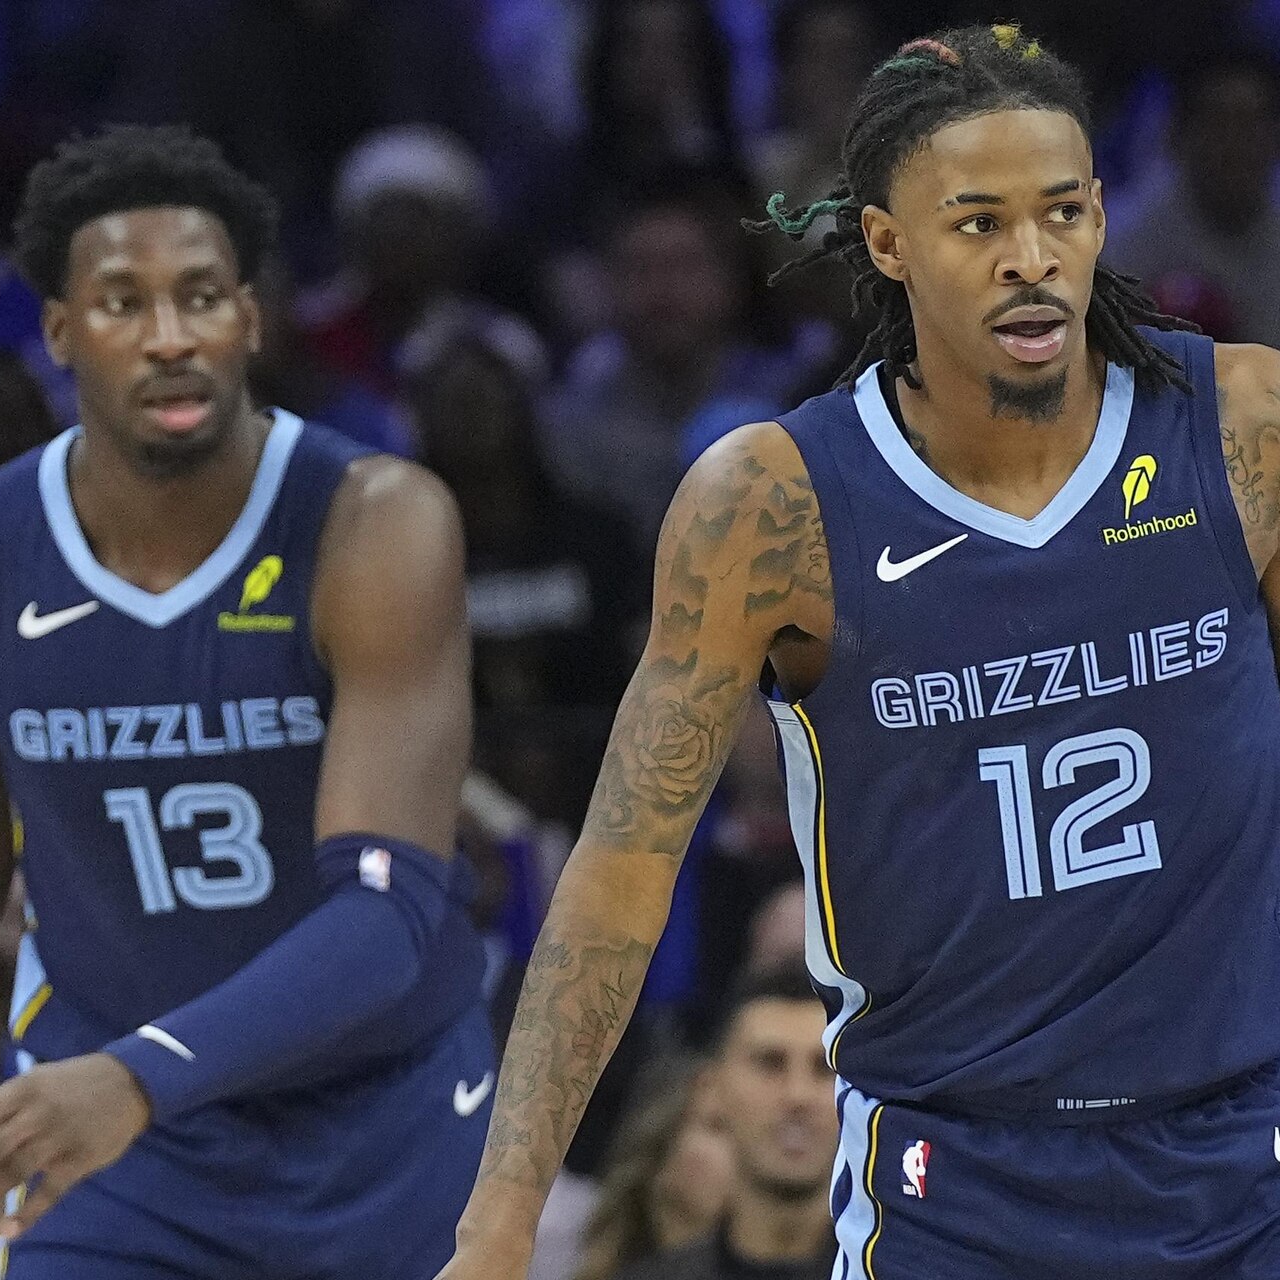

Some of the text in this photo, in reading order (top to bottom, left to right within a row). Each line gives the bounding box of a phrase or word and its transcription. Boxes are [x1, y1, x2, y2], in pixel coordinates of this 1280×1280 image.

[1102, 509, 1197, 546] Robinhood
[10, 696, 325, 762] GRIZZLIES
[871, 608, 1229, 729] GRIZZLIES
[104, 782, 275, 914] 13
[978, 727, 1162, 900] 12
